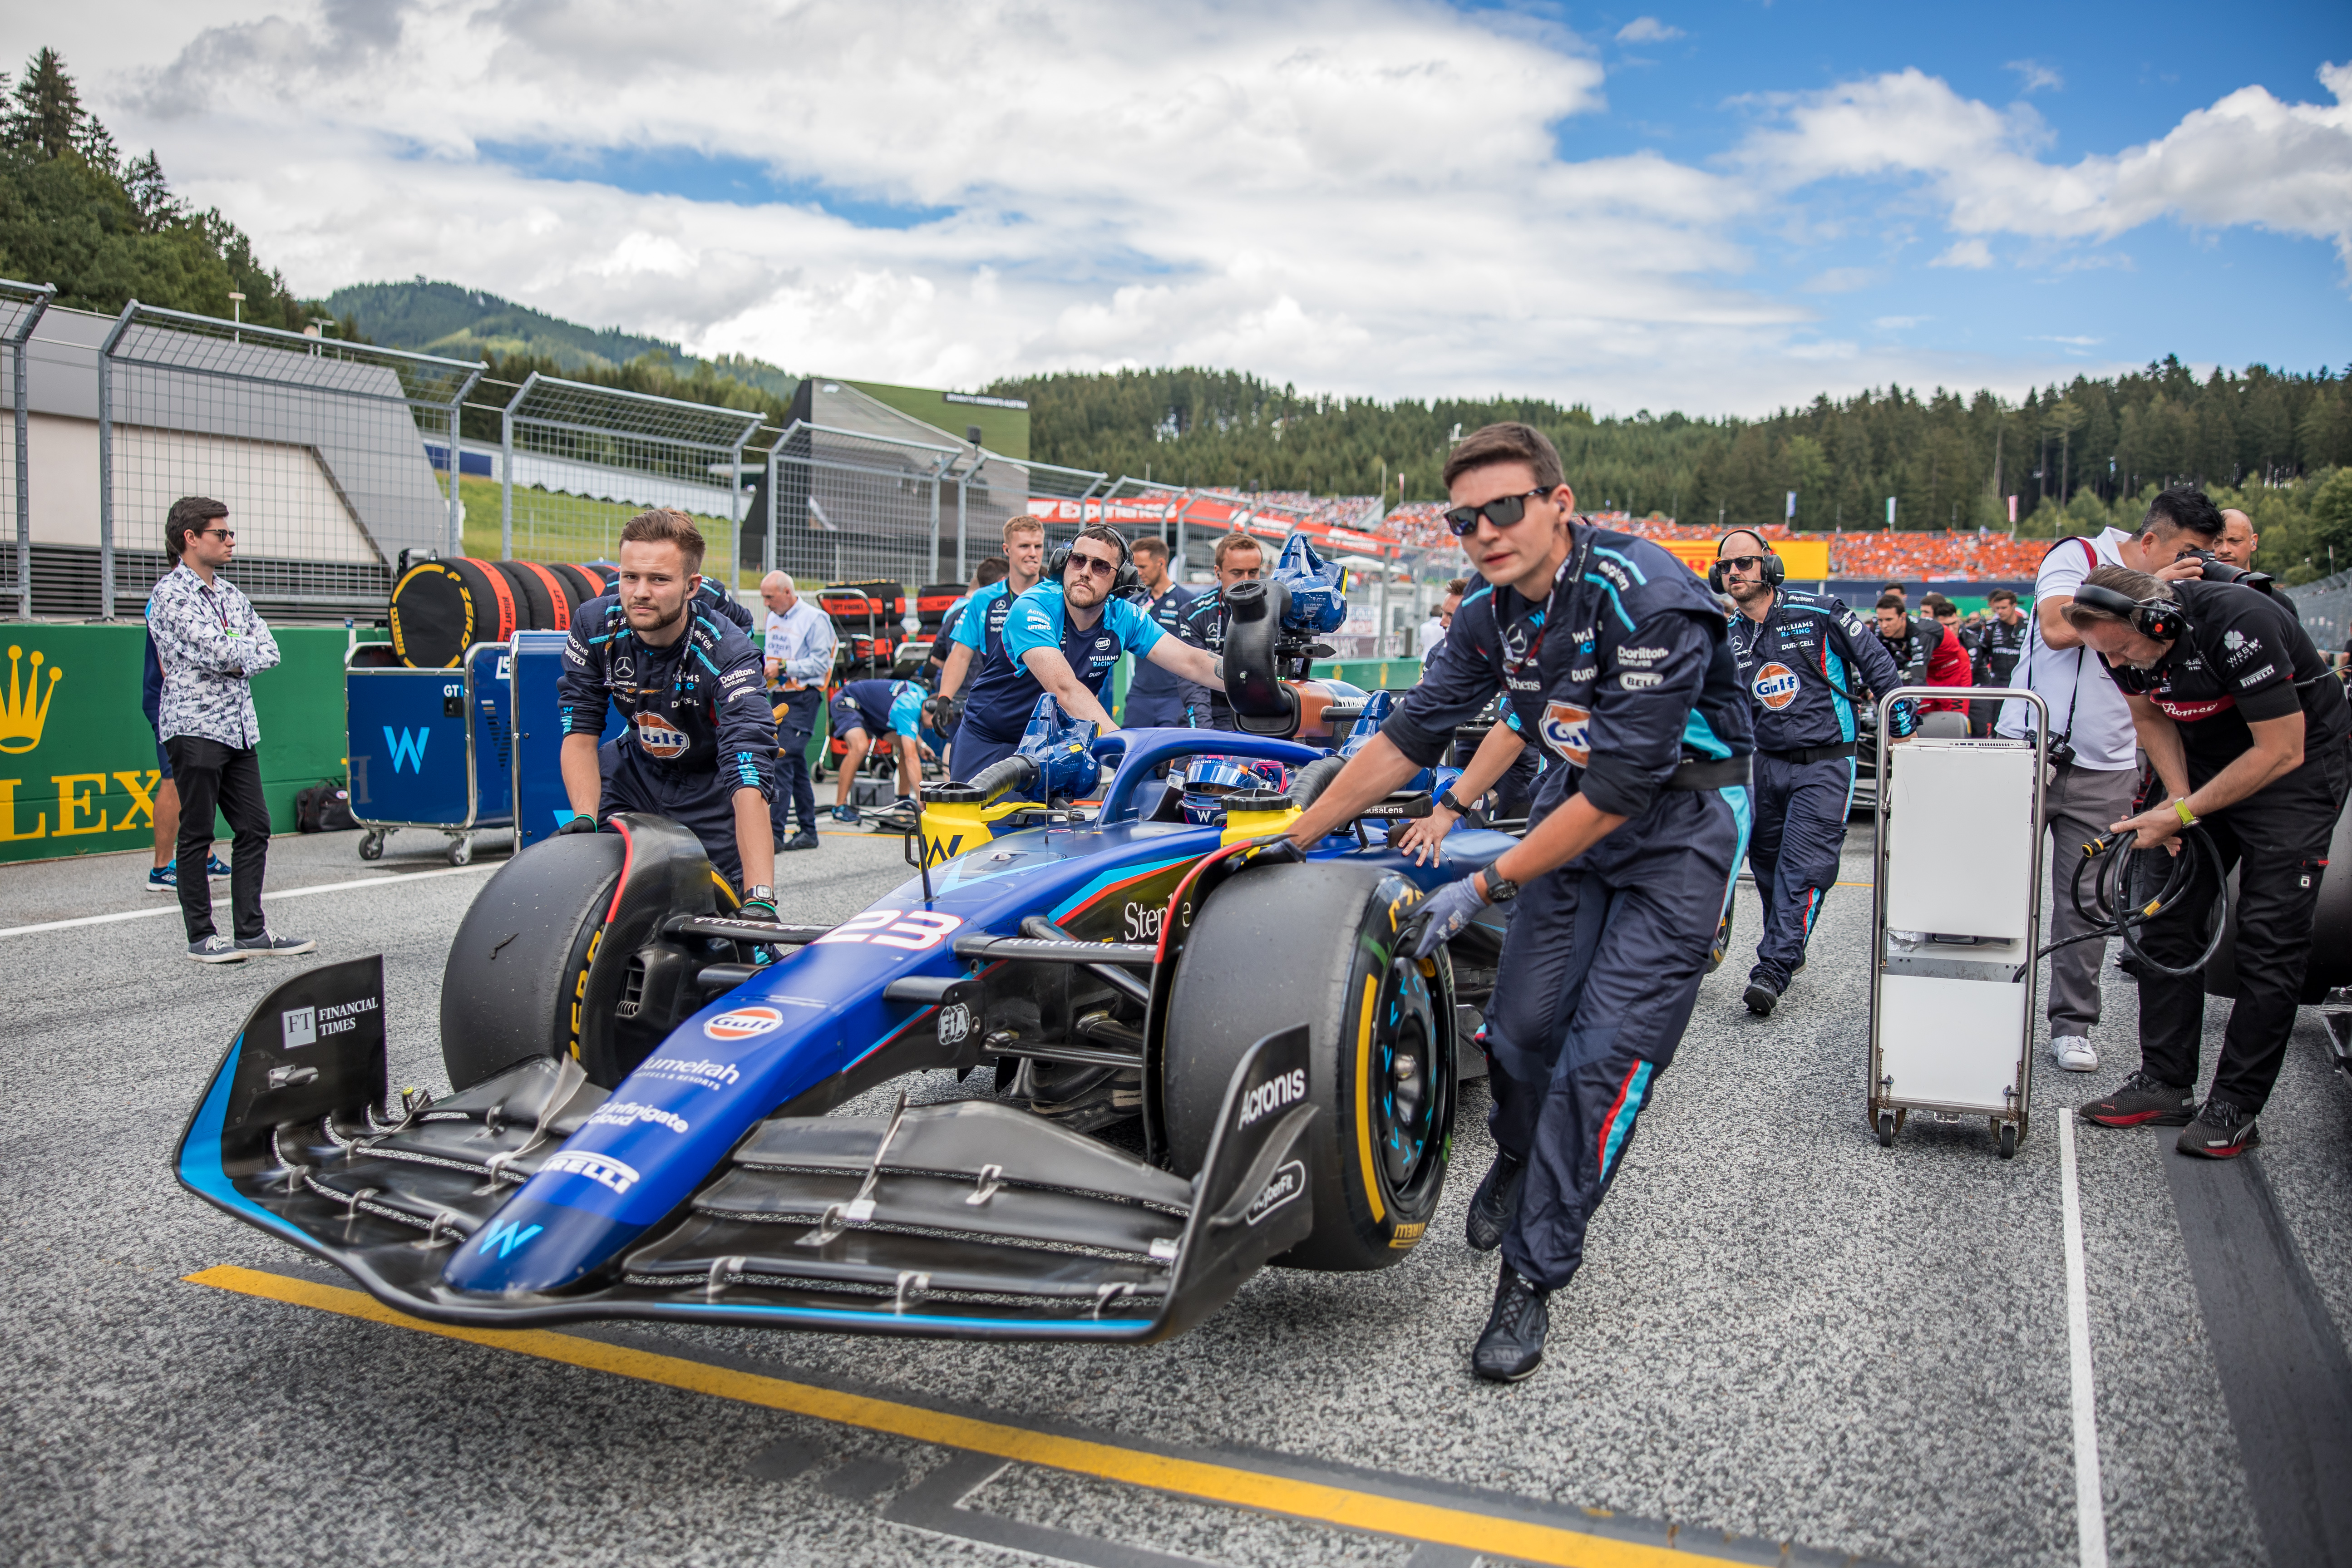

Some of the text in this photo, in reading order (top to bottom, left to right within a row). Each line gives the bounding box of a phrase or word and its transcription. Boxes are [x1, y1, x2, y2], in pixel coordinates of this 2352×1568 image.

[553, 590, 564, 611] LEFT
[459, 587, 473, 652] ZERO
[502, 597, 512, 624] RIGHT
[1027, 608, 1050, 621] Acronis
[1851, 624, 1860, 634] BELL
[568, 631, 589, 656] Acronis
[1617, 657, 1652, 667] Ventures
[2226, 646, 2249, 664] WEB
[2231, 644, 2263, 668] EYEWEAR
[723, 677, 746, 689] Ventures
[1756, 676, 1795, 695] Gulf
[2239, 664, 2275, 688] PIRELLI
[443, 684, 464, 697] GT1
[2162, 702, 2218, 716] Romeo
[383, 725, 430, 775] W
[1248, 771, 1261, 780] DURACELL
[1197, 810, 1211, 823] W
[810, 909, 964, 951] 23
[287, 997, 379, 1033] FT FINANCIAL
[712, 1016, 778, 1031] Gulf
[320, 1017, 356, 1036] TIMES
[676, 1074, 721, 1091] RESORTS
[1237, 1068, 1307, 1131] Acronis
[588, 1112, 637, 1127] cloud
[607, 1101, 690, 1134] infinigate
[1469, 1210, 1495, 1242] OMP
[478, 1219, 544, 1259] W
[1477, 1349, 1524, 1362] OMP
